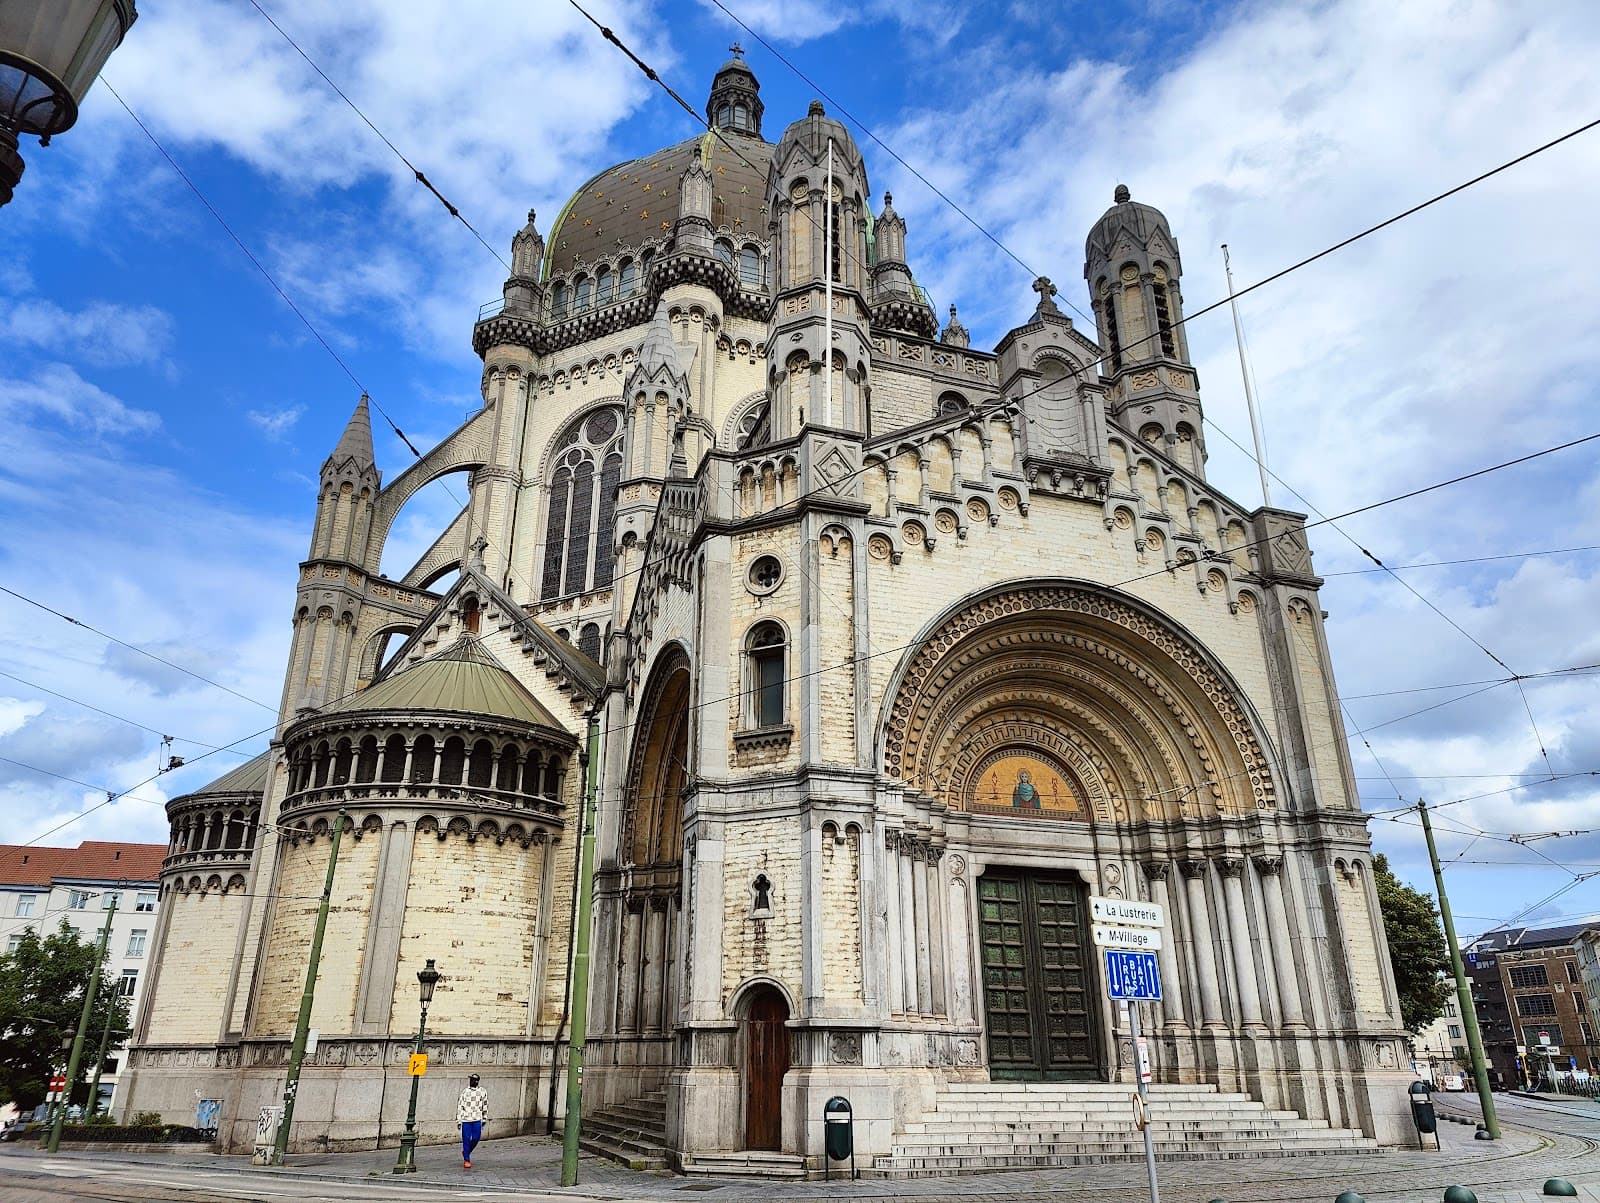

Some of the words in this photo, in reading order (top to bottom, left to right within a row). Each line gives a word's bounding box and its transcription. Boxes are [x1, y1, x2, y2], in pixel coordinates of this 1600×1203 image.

[1106, 904, 1116, 916] La
[1119, 905, 1156, 920] Lustrerie
[1109, 930, 1148, 945] M-Village
[1129, 960, 1138, 990] BUS
[1135, 956, 1145, 996] TAXI
